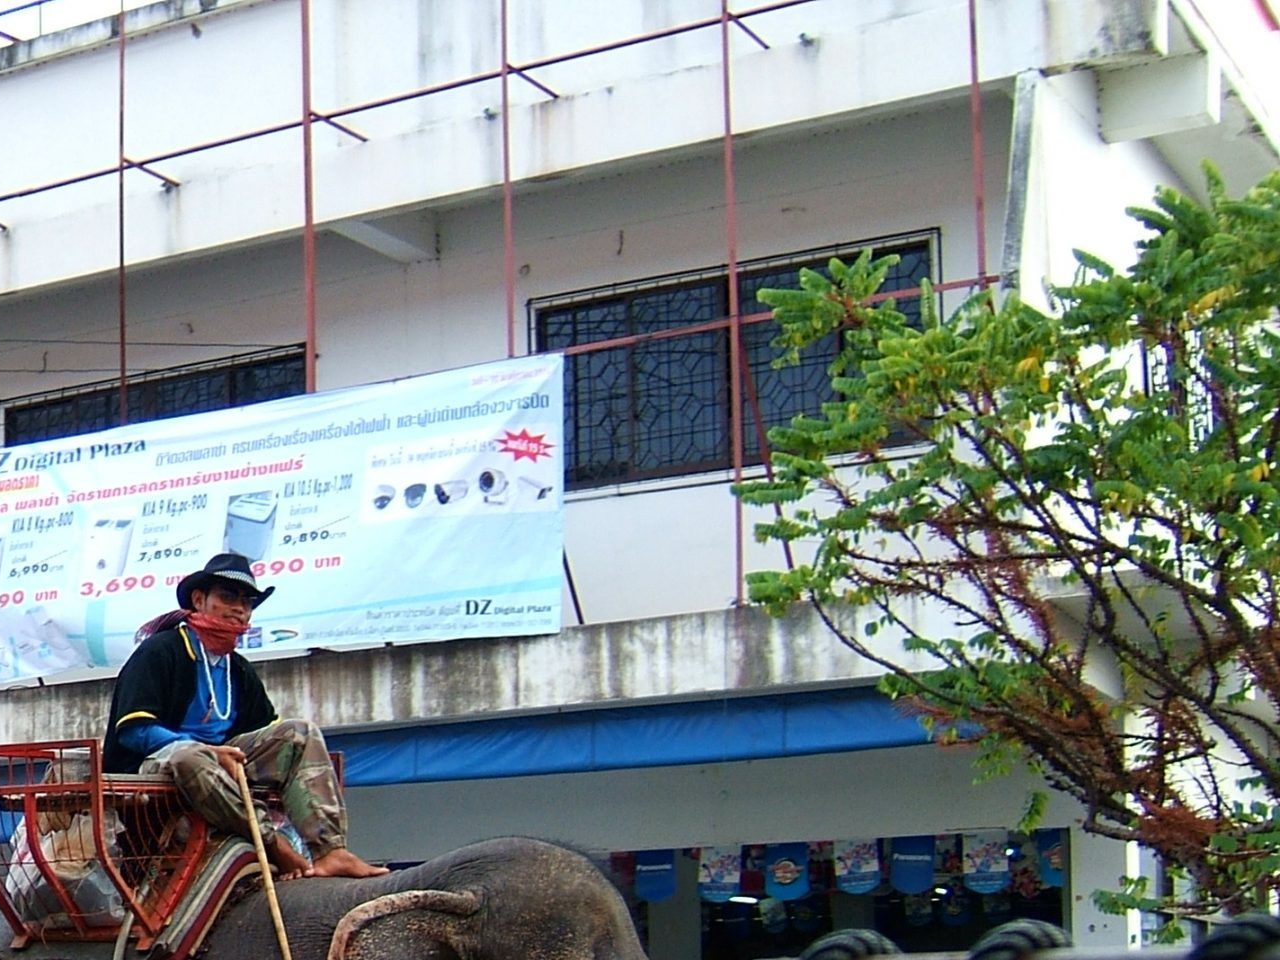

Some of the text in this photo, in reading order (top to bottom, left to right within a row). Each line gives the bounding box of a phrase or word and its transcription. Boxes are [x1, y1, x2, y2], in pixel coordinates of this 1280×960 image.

[14, 447, 81, 471] Digital
[90, 439, 146, 459] Plaza
[137, 547, 182, 562] 7,890
[9, 563, 49, 578] 6,990
[251, 556, 341, 577] 890 บาท
[80, 575, 183, 597] 3,690 บา
[35, 590, 58, 602] บาท
[465, 599, 552, 616] DZ Digital Plaza
